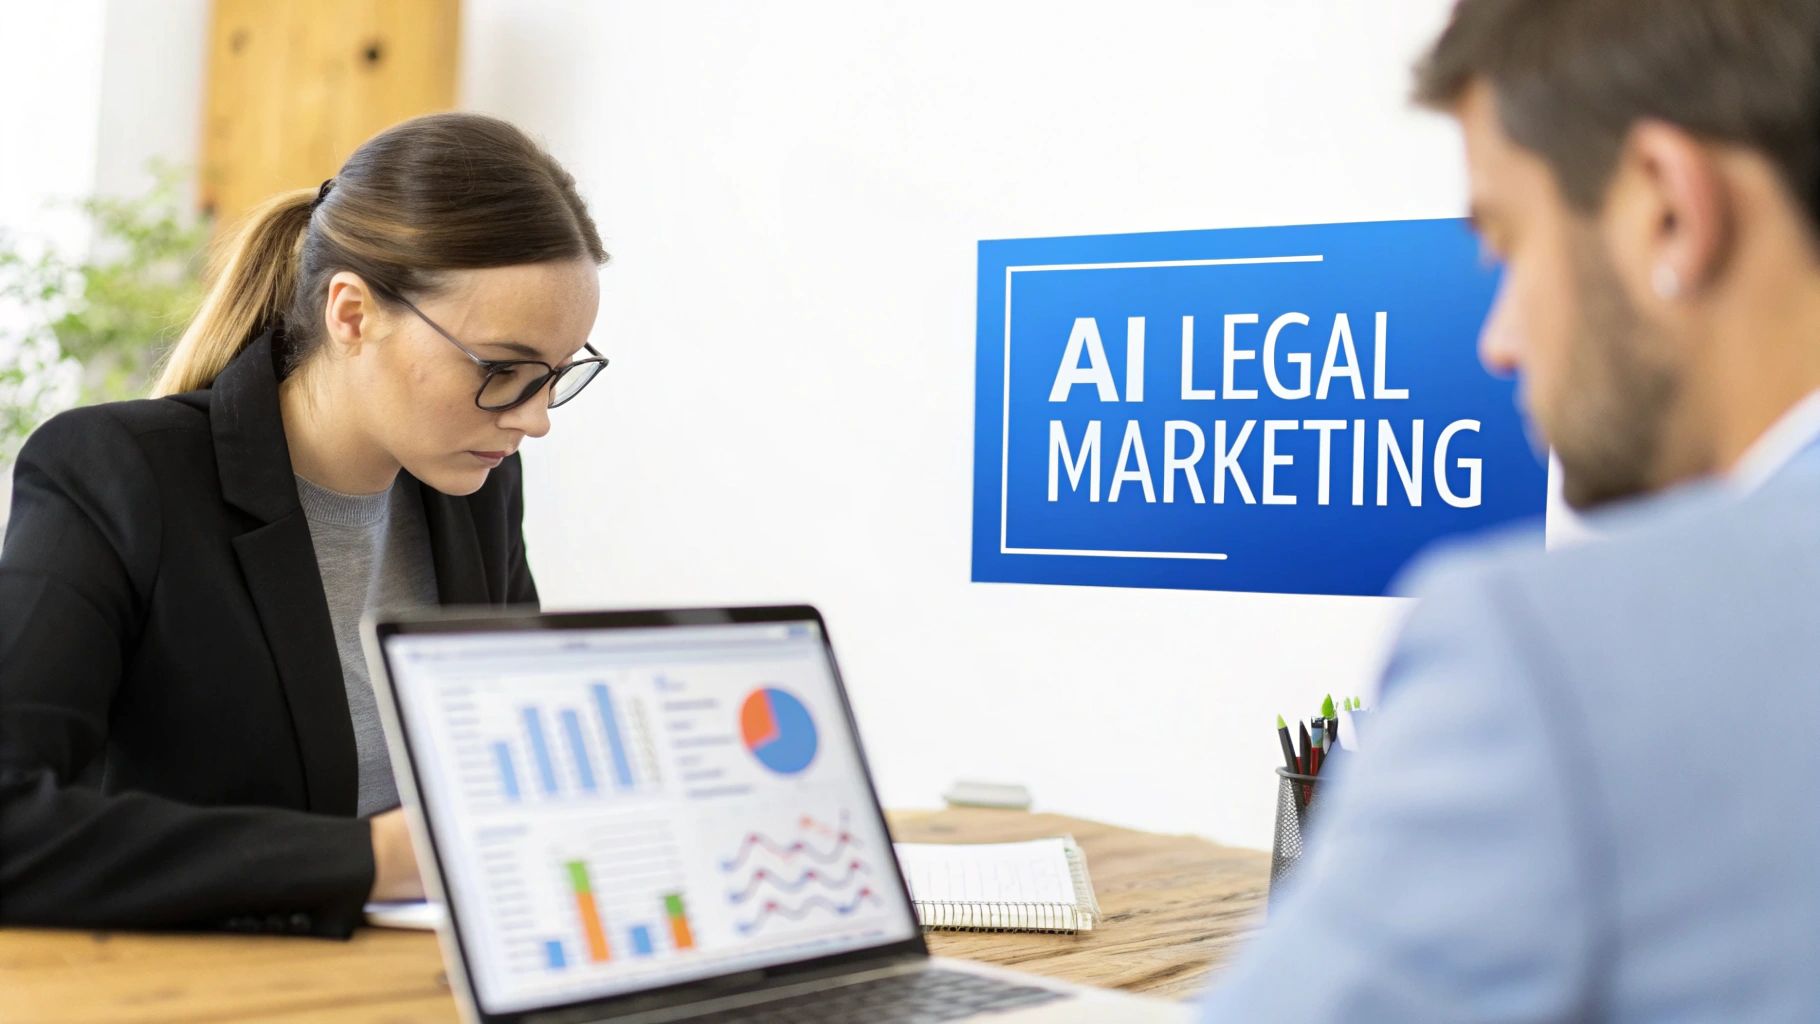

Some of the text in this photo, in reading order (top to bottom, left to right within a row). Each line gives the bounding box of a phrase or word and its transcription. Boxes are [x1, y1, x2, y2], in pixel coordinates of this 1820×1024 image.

[1048, 311, 1409, 403] AI LEGAL
[1047, 418, 1483, 508] MARKETING
